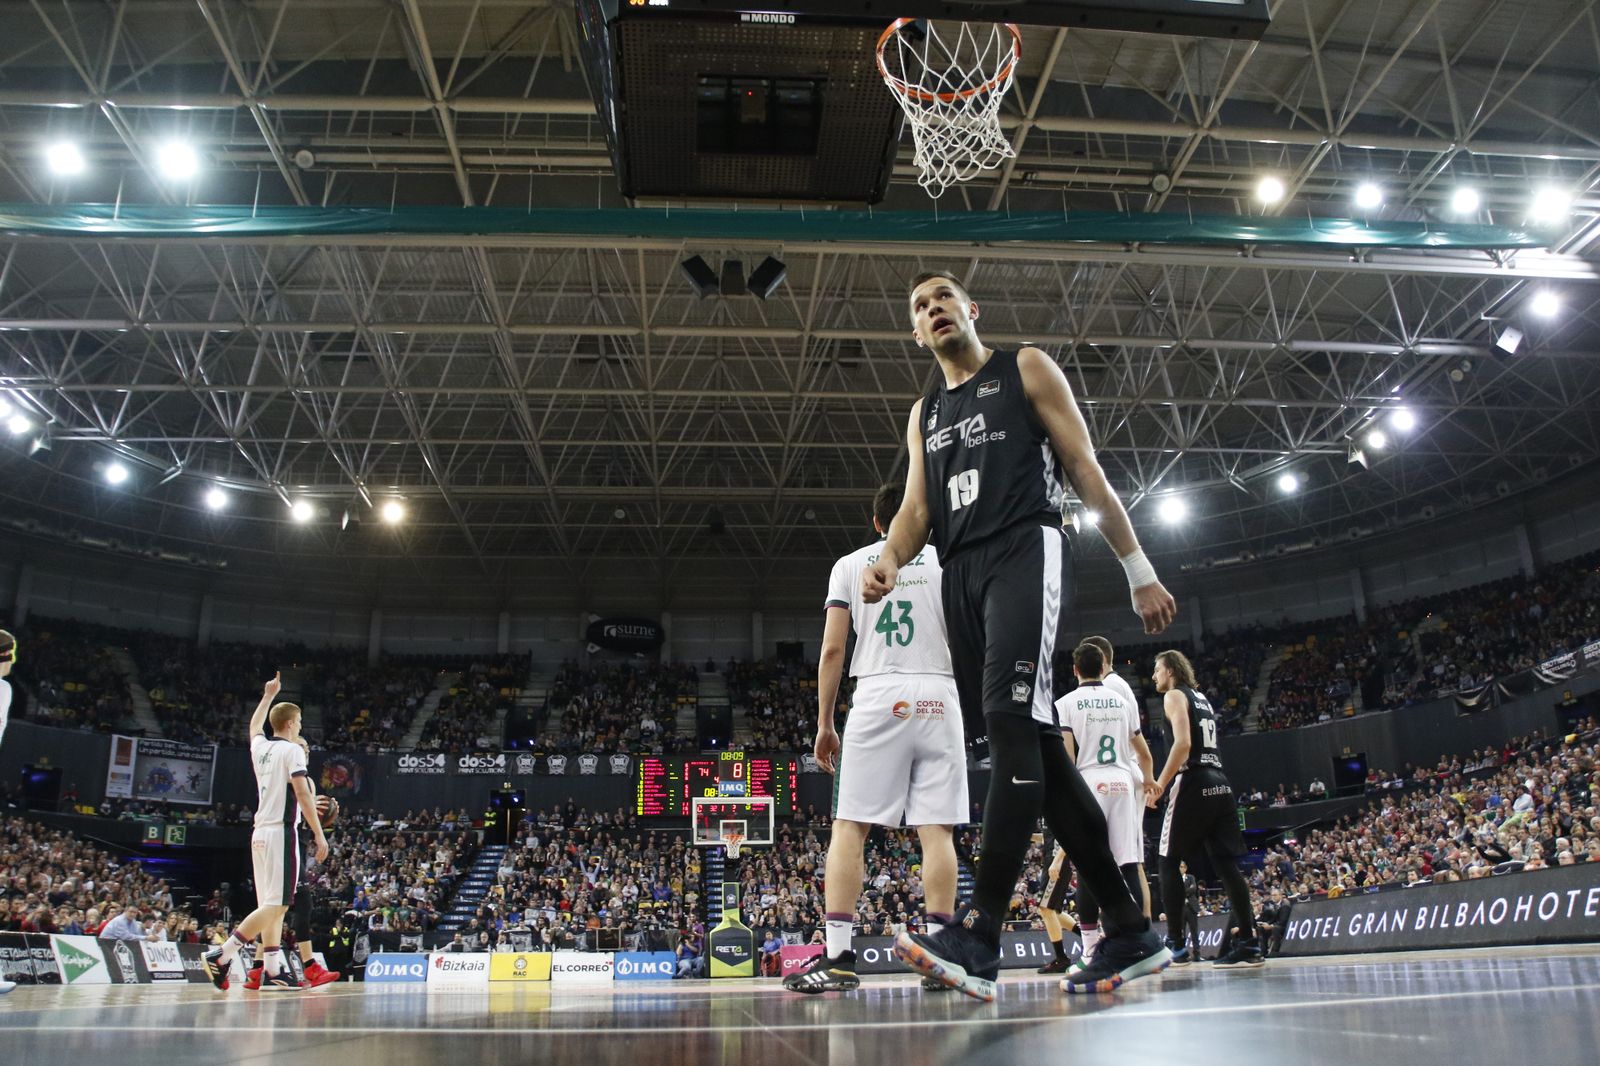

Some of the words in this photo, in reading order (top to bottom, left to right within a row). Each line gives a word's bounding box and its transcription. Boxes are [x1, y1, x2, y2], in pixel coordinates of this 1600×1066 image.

[751, 13, 796, 24] MONDO
[926, 413, 987, 453] RETA
[967, 431, 1007, 448] bet.es
[947, 468, 979, 511] 19
[875, 600, 914, 647] 43
[916, 700, 944, 708] COSTA
[1199, 718, 1218, 749] 12
[1097, 734, 1117, 765] 8
[721, 752, 744, 761] 08:09
[698, 768, 709, 777] 74
[733, 763, 743, 778] 8
[721, 784, 745, 792] IMQ
[148, 826, 158, 839] B
[1285, 916, 1341, 940] HOTEL
[1349, 909, 1408, 936] GRAN
[1415, 897, 1508, 930] BILBAO
[384, 964, 424, 977] IMQ
[442, 960, 485, 971] Bizkaia
[634, 962, 674, 975] IMQ
